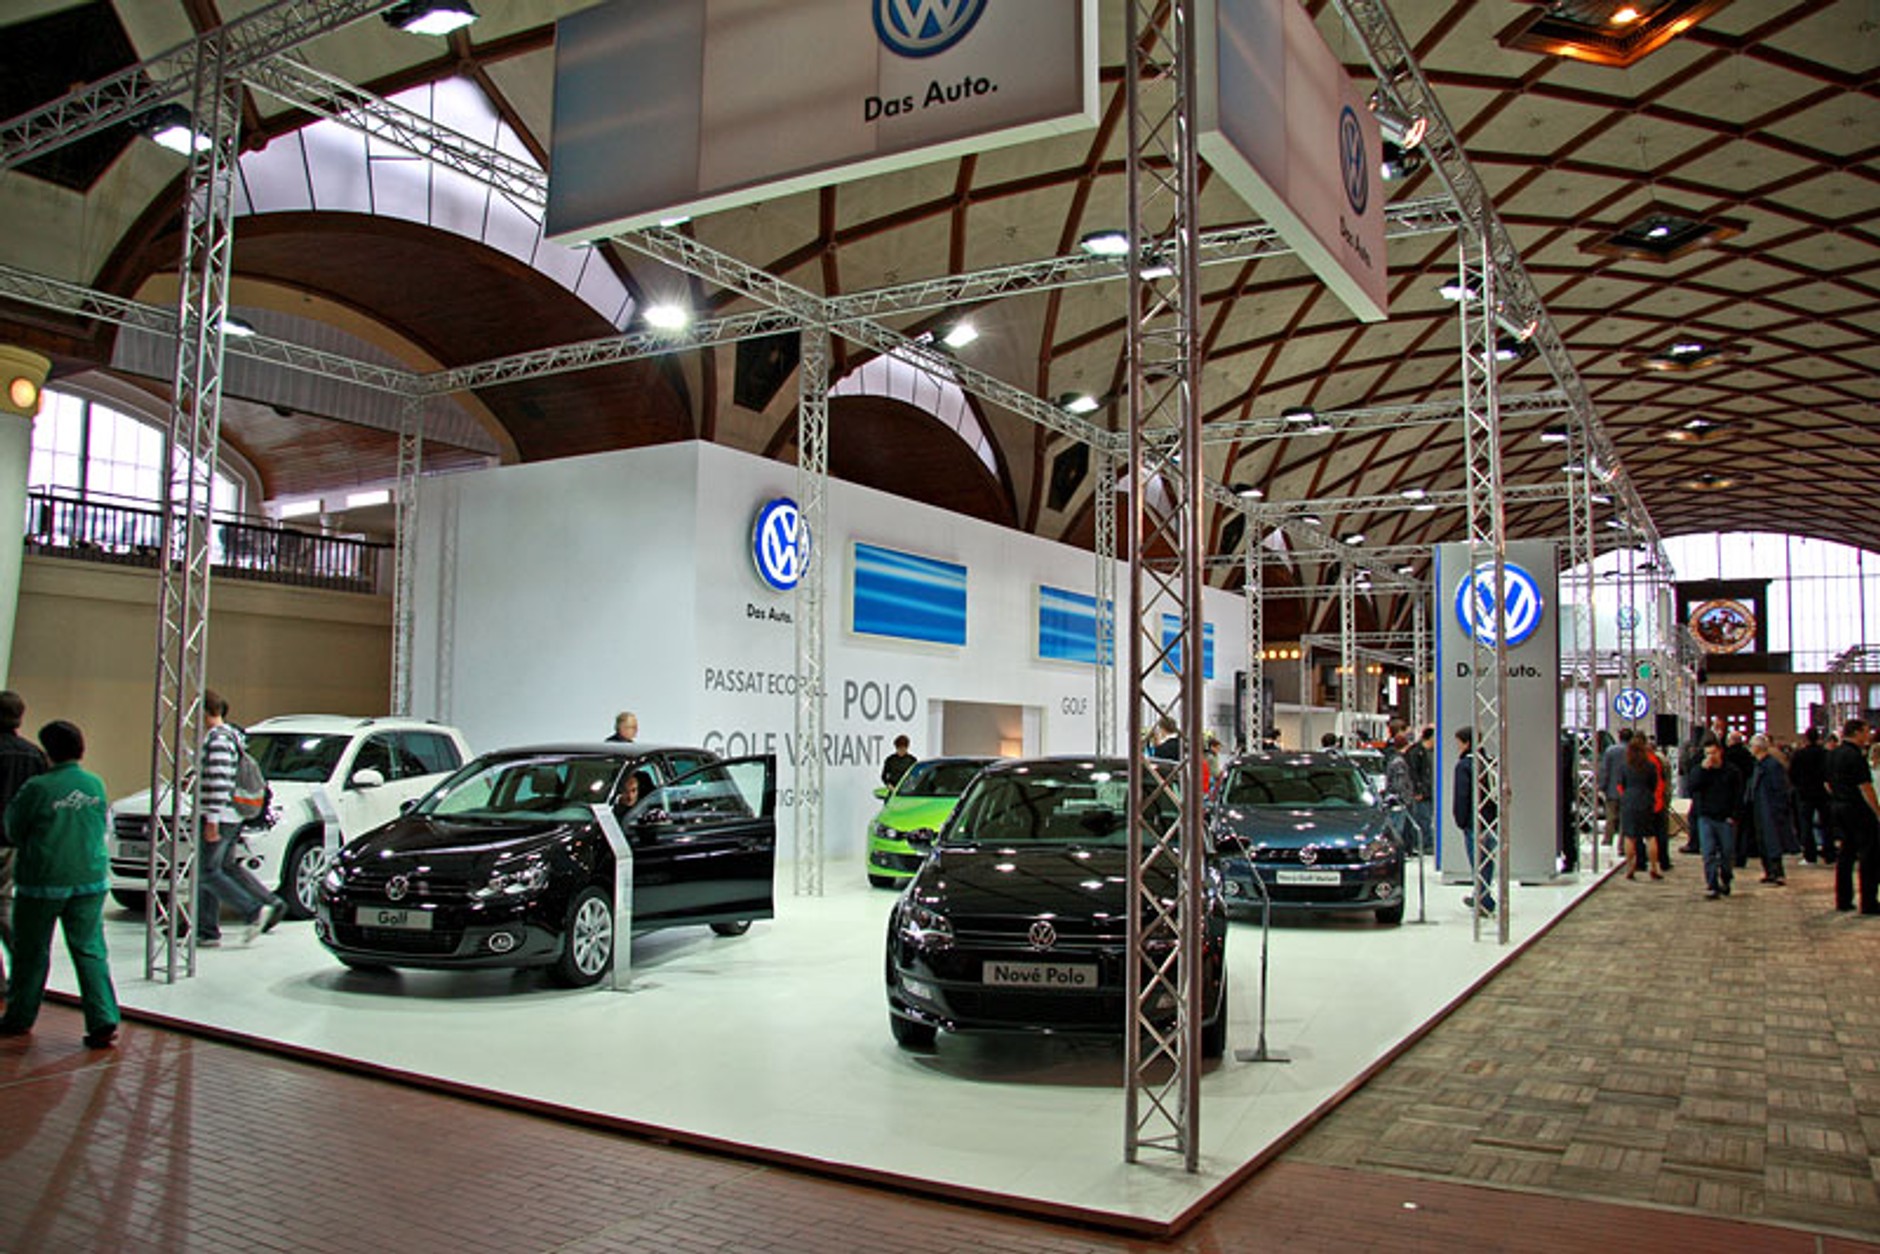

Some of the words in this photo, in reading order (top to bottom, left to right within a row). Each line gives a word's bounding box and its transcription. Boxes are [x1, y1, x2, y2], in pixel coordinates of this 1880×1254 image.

[864, 96, 914, 123] Das
[922, 76, 999, 109] Auto.
[746, 603, 766, 620] Das
[768, 607, 794, 623] Auto.
[704, 667, 765, 694] PASSAT
[1502, 664, 1542, 678] uto.
[843, 679, 917, 722] POLO
[1061, 696, 1087, 715] GOLF
[993, 965, 1042, 983] Nové
[1046, 966, 1086, 984] Polo
